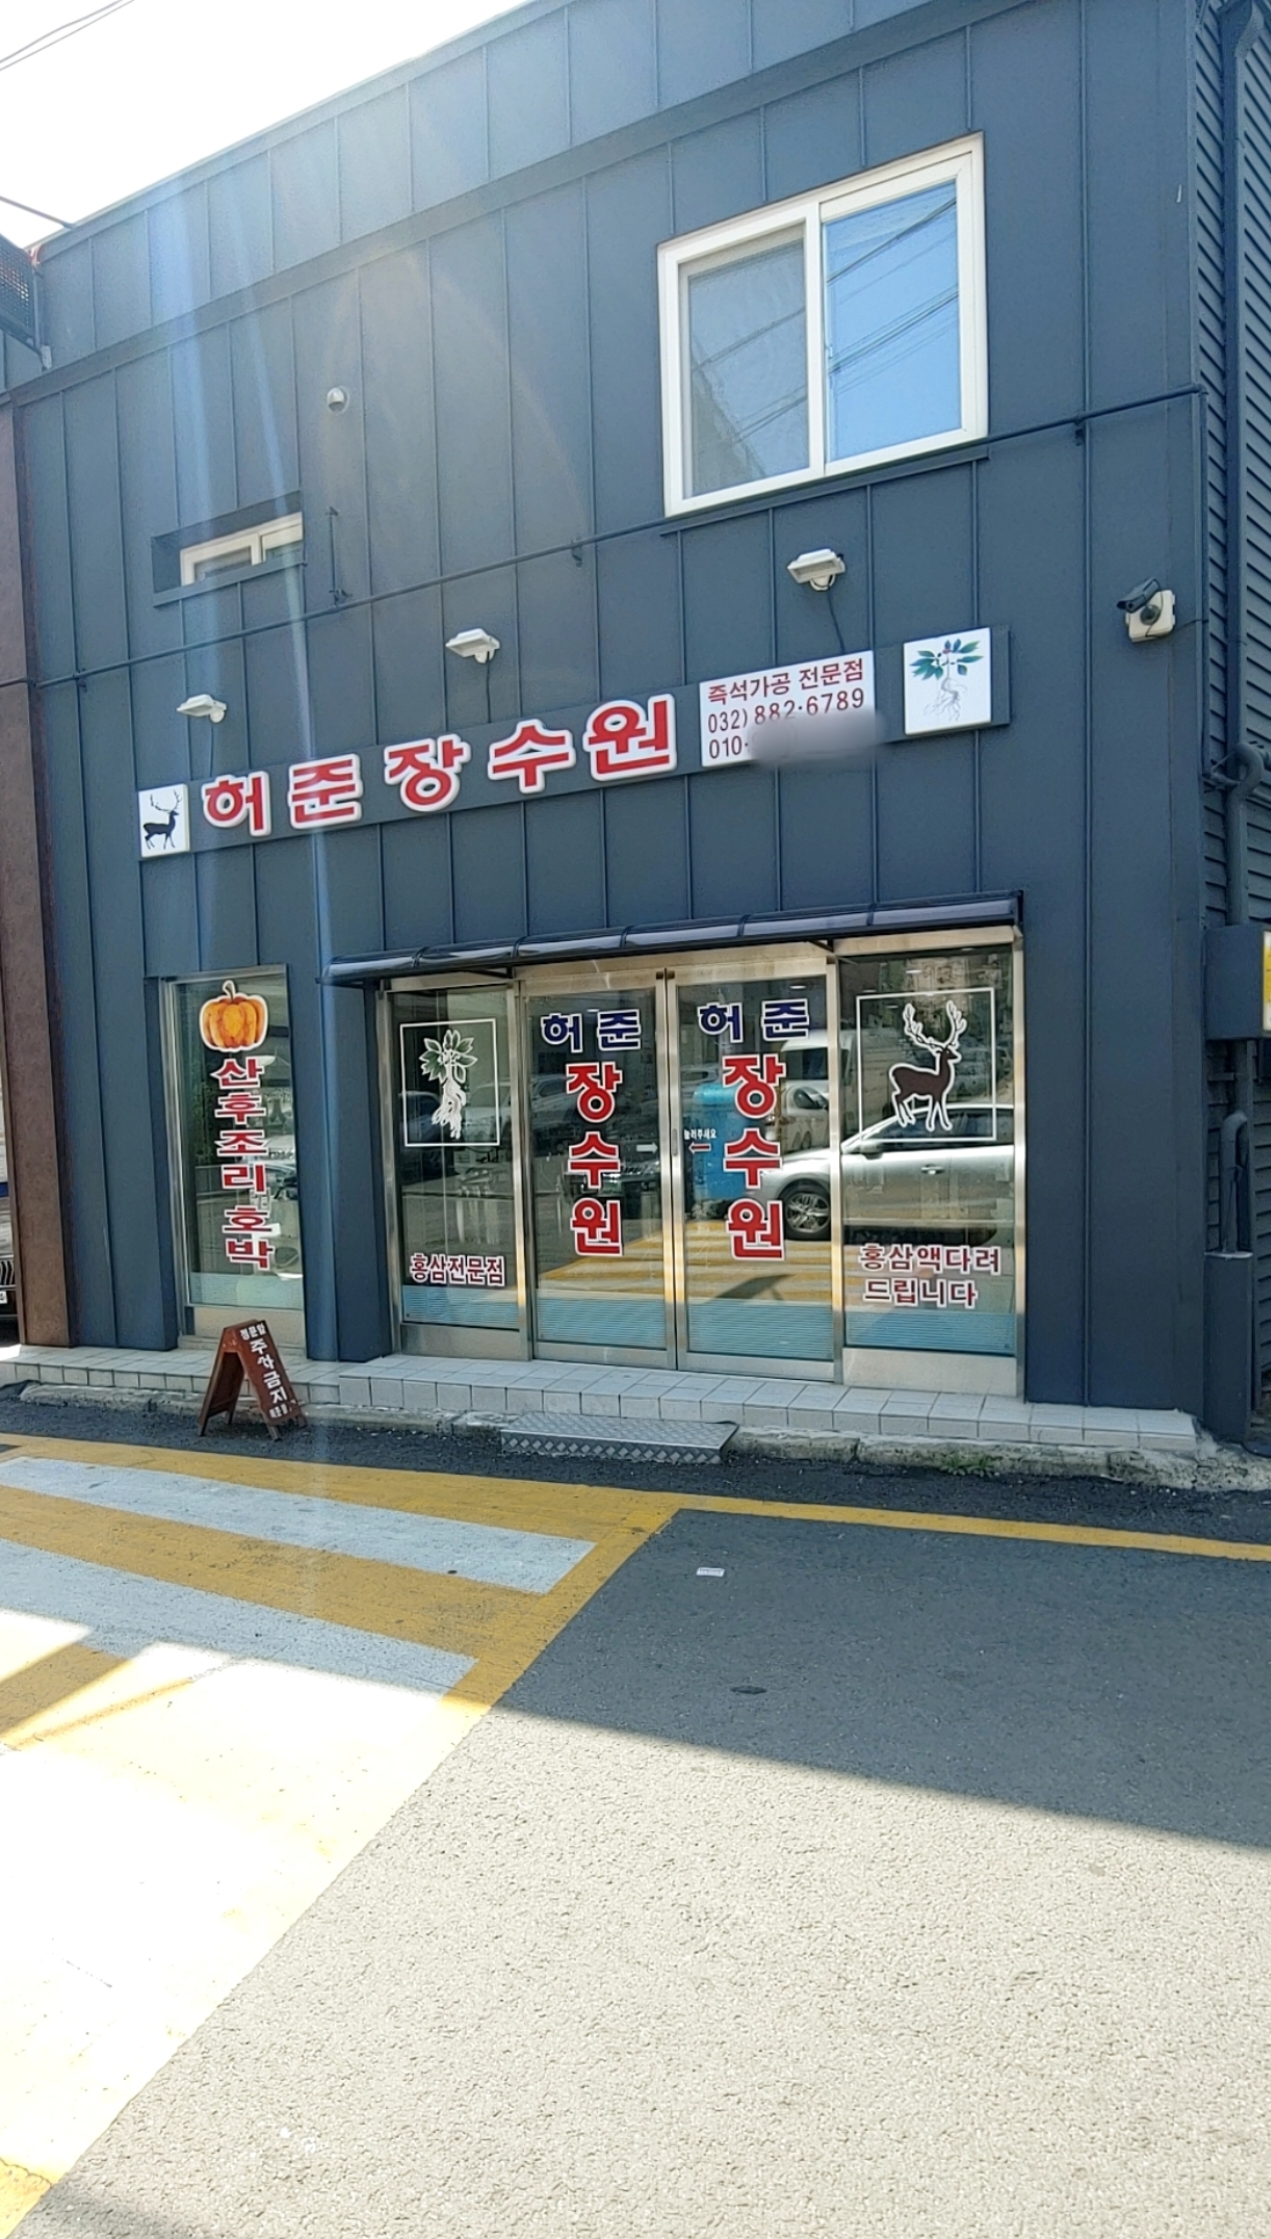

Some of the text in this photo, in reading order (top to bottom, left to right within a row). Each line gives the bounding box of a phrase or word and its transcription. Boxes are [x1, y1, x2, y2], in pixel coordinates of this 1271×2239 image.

[708, 658, 863, 705] 즉석가공 전문점
[708, 708, 748, 733] 032)
[541, 1009, 641, 1052] 허준
[698, 999, 809, 1042] 허준
[210, 1056, 274, 1270] 산후조리 호박
[566, 1061, 624, 1256] 장수원
[722, 1054, 786, 1260] 장수원
[410, 1252, 505, 1288] 홍삼전문점
[860, 1243, 1001, 1275] 홍삼액다려
[863, 1277, 978, 1309] 드립니다
